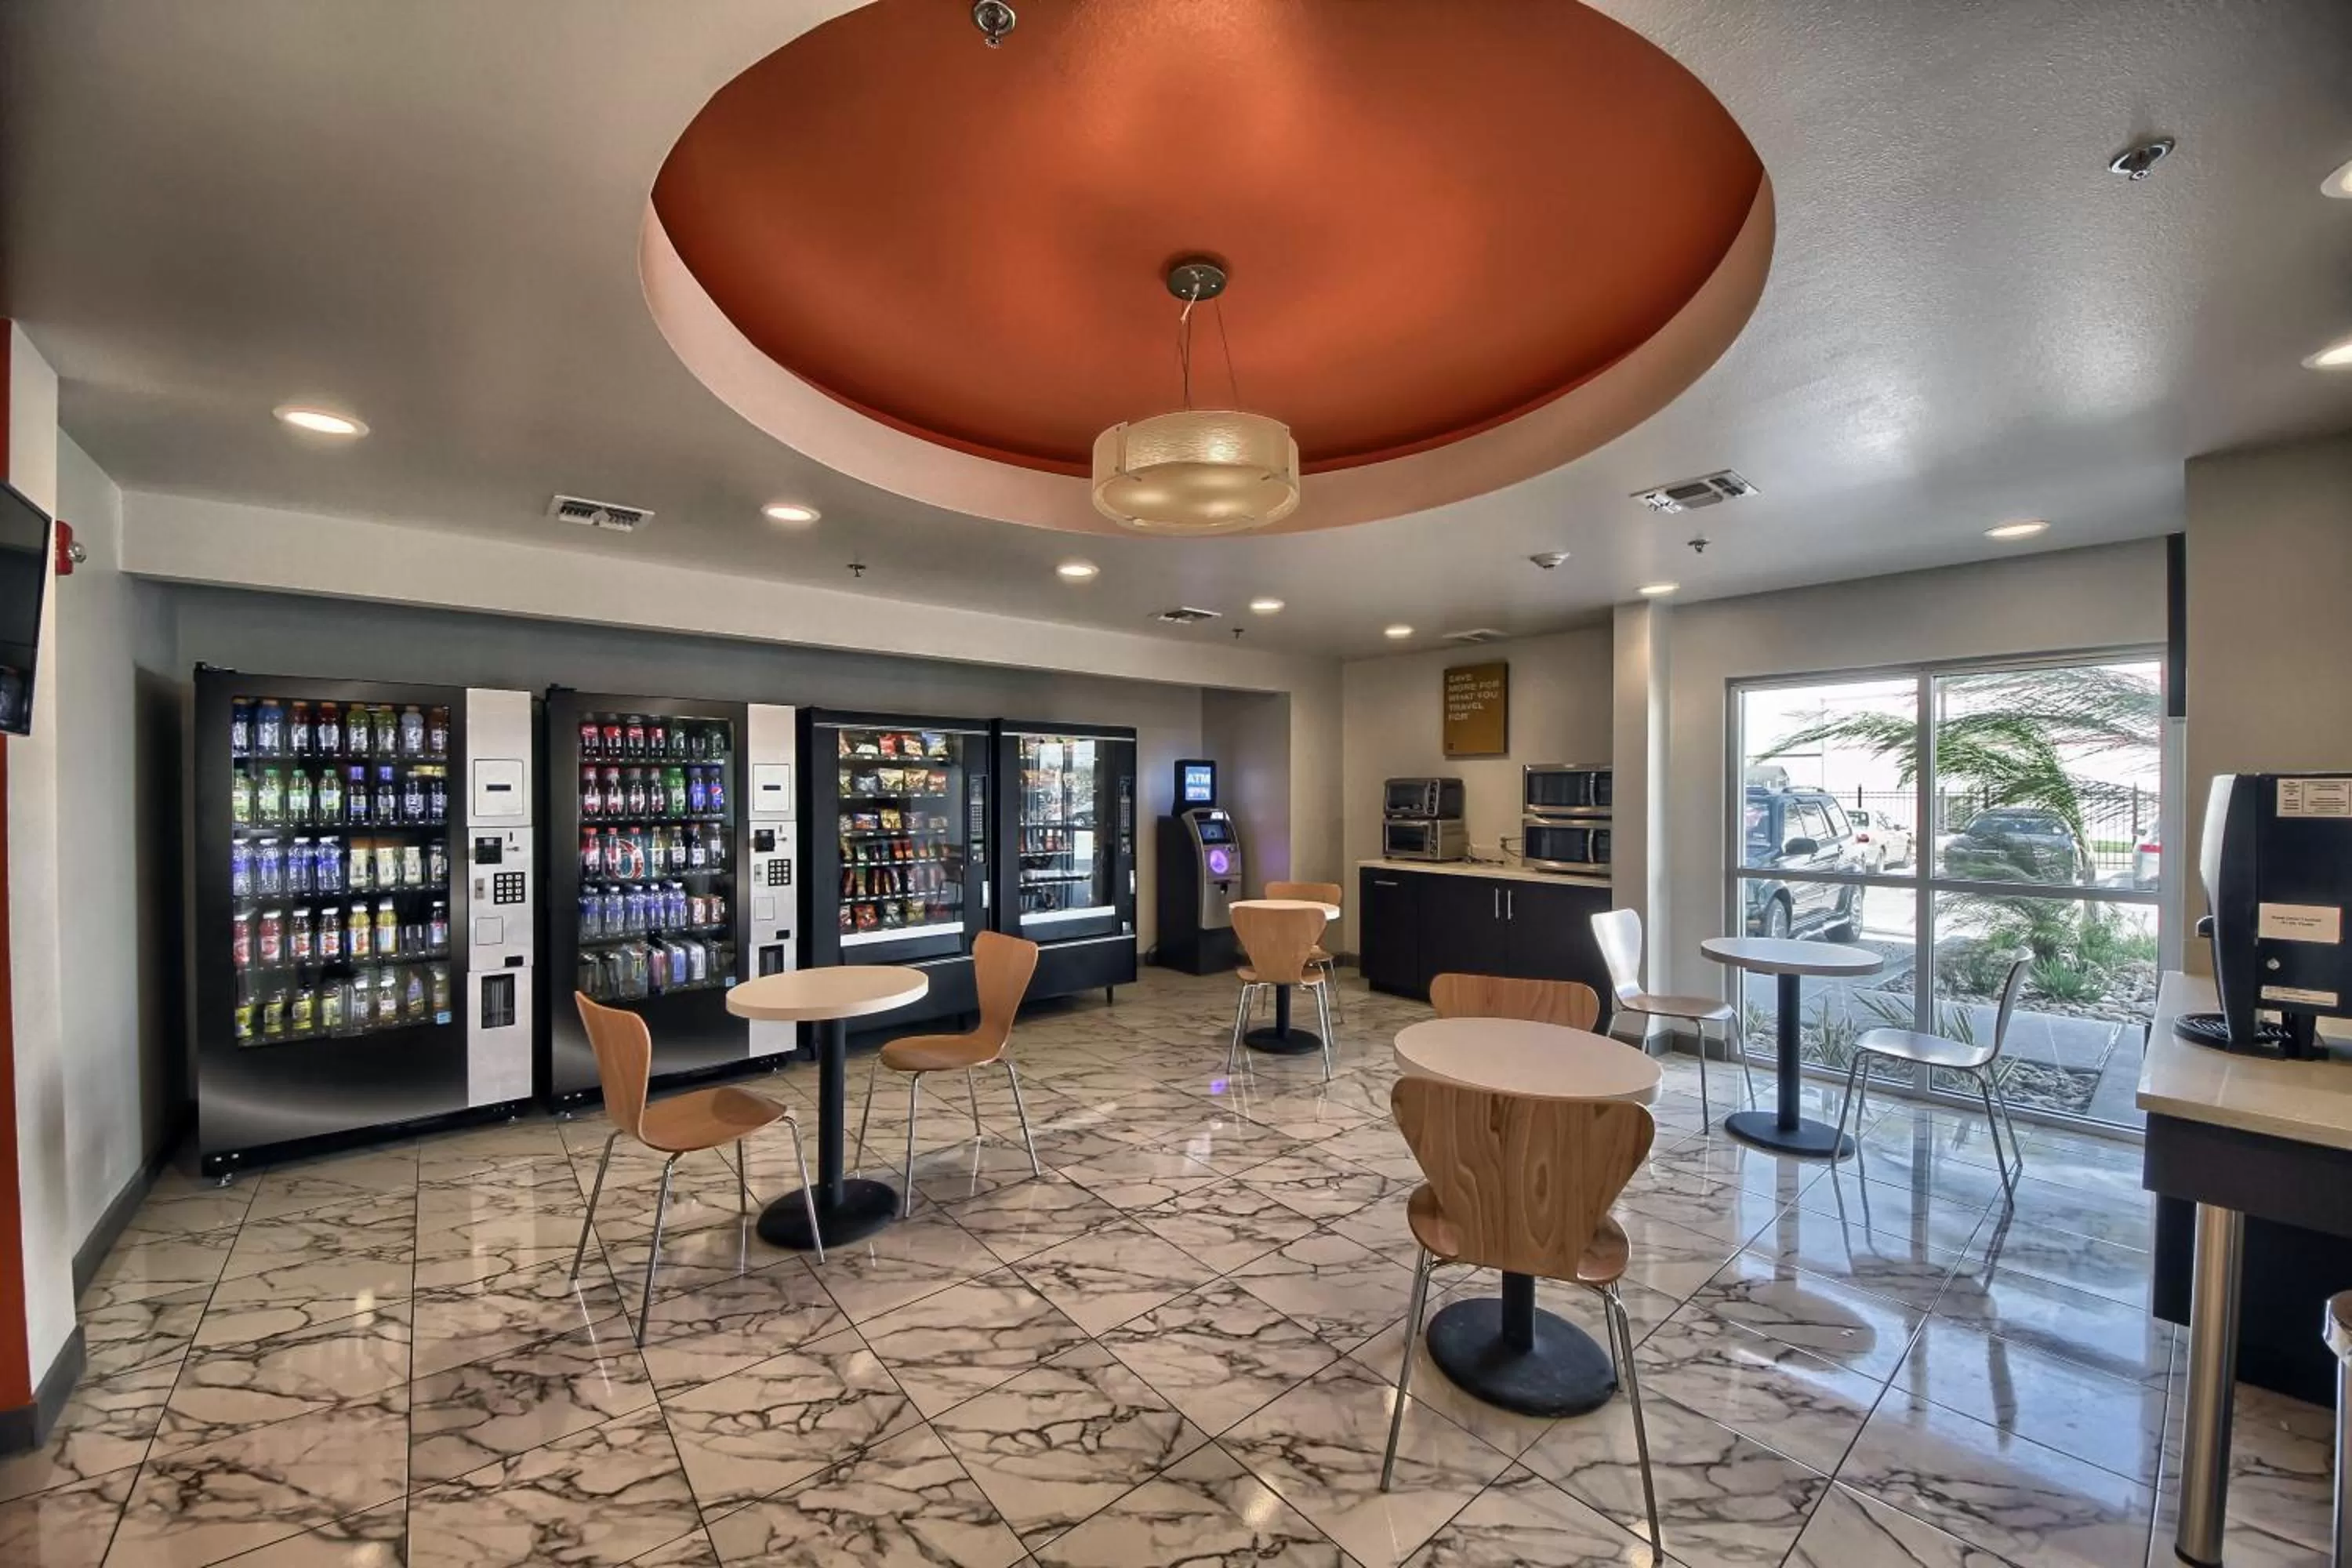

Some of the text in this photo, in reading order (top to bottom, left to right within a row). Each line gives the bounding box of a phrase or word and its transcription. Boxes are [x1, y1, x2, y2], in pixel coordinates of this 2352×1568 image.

[1448, 673, 1473, 682] SAVE
[1448, 680, 1500, 691] MORE FOR
[1448, 691, 1498, 702] WHAT YOU
[1448, 702, 1485, 712] TRAVEL
[1186, 773, 1210, 784] ATM
